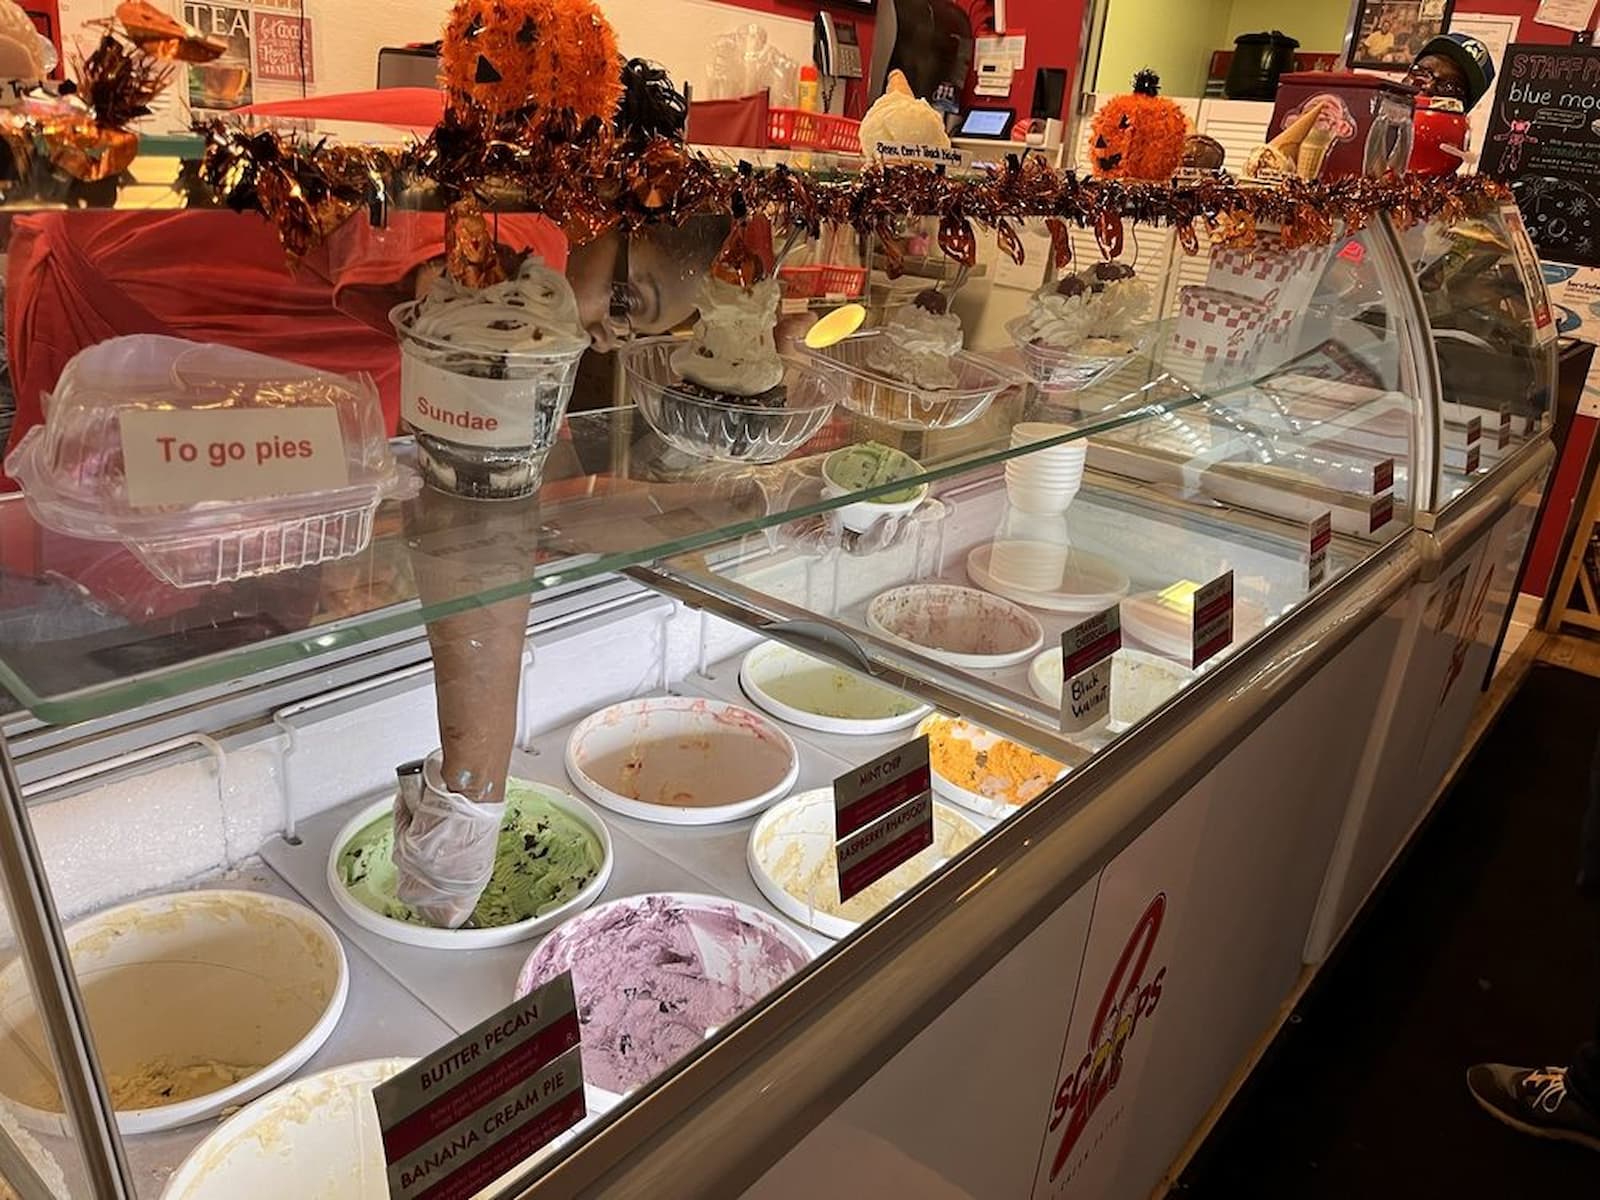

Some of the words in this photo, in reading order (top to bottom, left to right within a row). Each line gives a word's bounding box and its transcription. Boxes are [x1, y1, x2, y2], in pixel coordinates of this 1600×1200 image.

[184, 3, 250, 38] TEA
[1512, 54, 1583, 81] STAFF
[1509, 81, 1552, 106] blue
[416, 396, 498, 432] Sundae
[156, 437, 198, 463] To
[207, 438, 245, 466] go
[254, 434, 313, 464] pies
[858, 765, 881, 787] MINT
[880, 755, 902, 776] CHIP
[838, 825, 883, 861] RASPBERRY
[882, 800, 928, 835] RHAPSODY
[420, 1042, 480, 1091] BUTTER
[484, 1004, 538, 1051] PECAN
[400, 1128, 479, 1190] BANANA
[482, 1090, 540, 1134] CREAM
[542, 1071, 565, 1097] PIE
